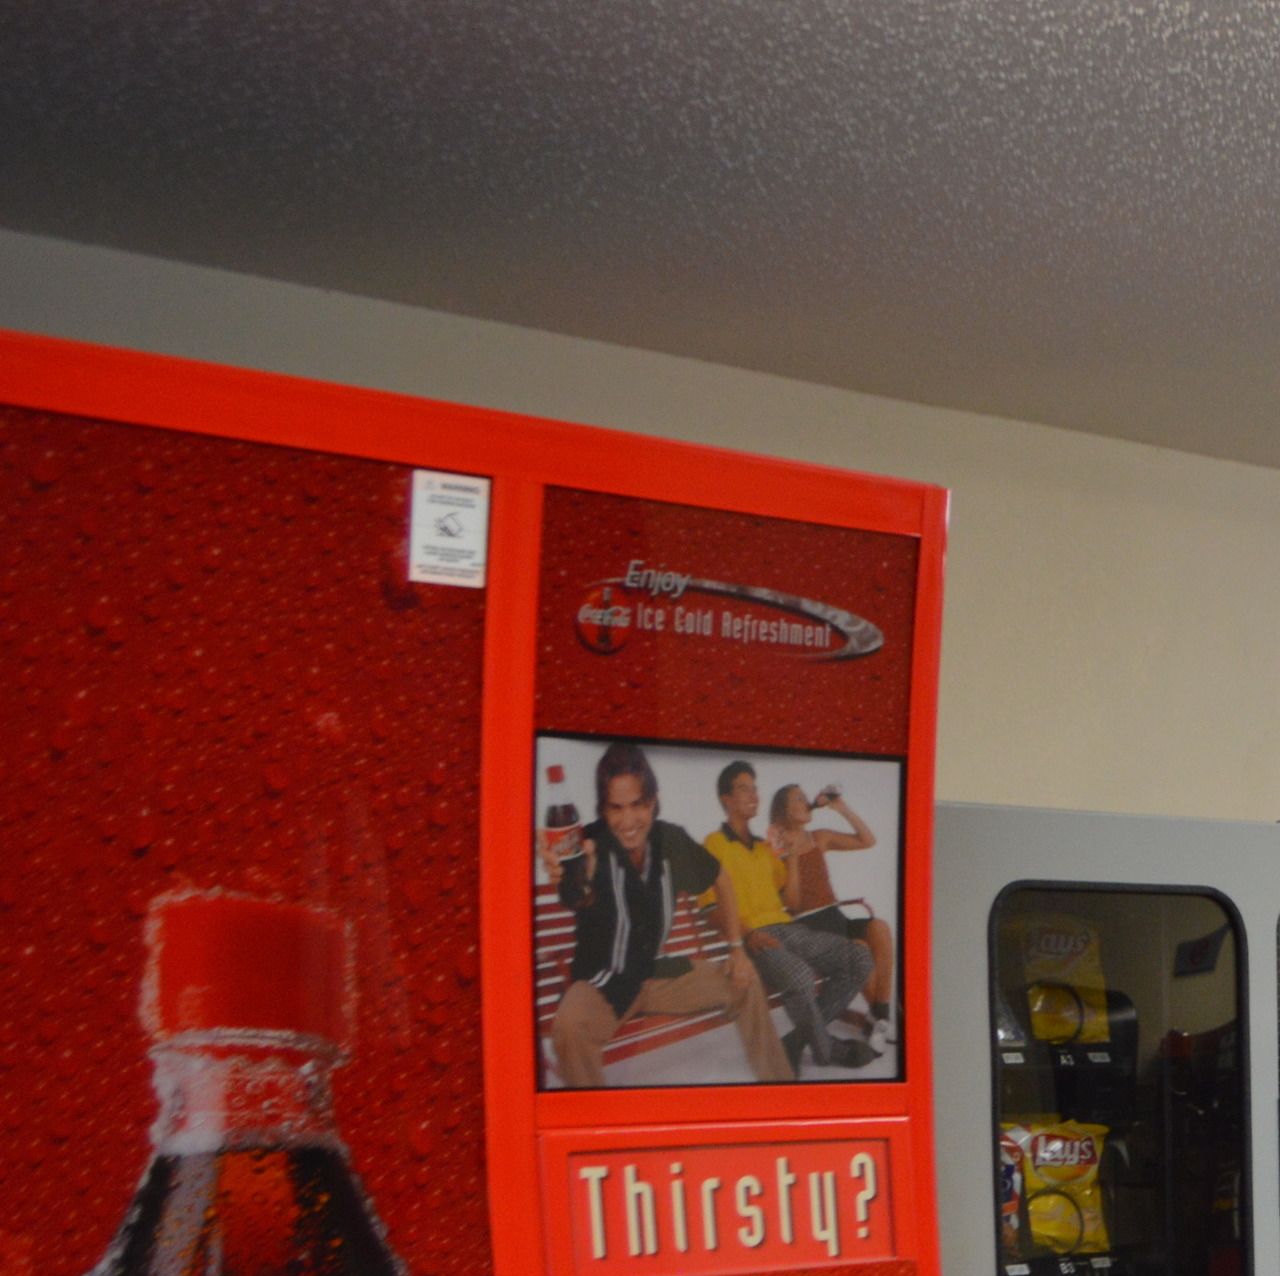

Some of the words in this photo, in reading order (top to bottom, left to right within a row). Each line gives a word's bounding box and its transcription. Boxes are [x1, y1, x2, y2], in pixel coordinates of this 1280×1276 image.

[625, 560, 691, 597] Enjoy
[636, 602, 665, 630] Ice
[674, 605, 714, 636] Cold
[721, 611, 832, 648] Refreshment
[579, 1152, 877, 1259] Thirsty?
